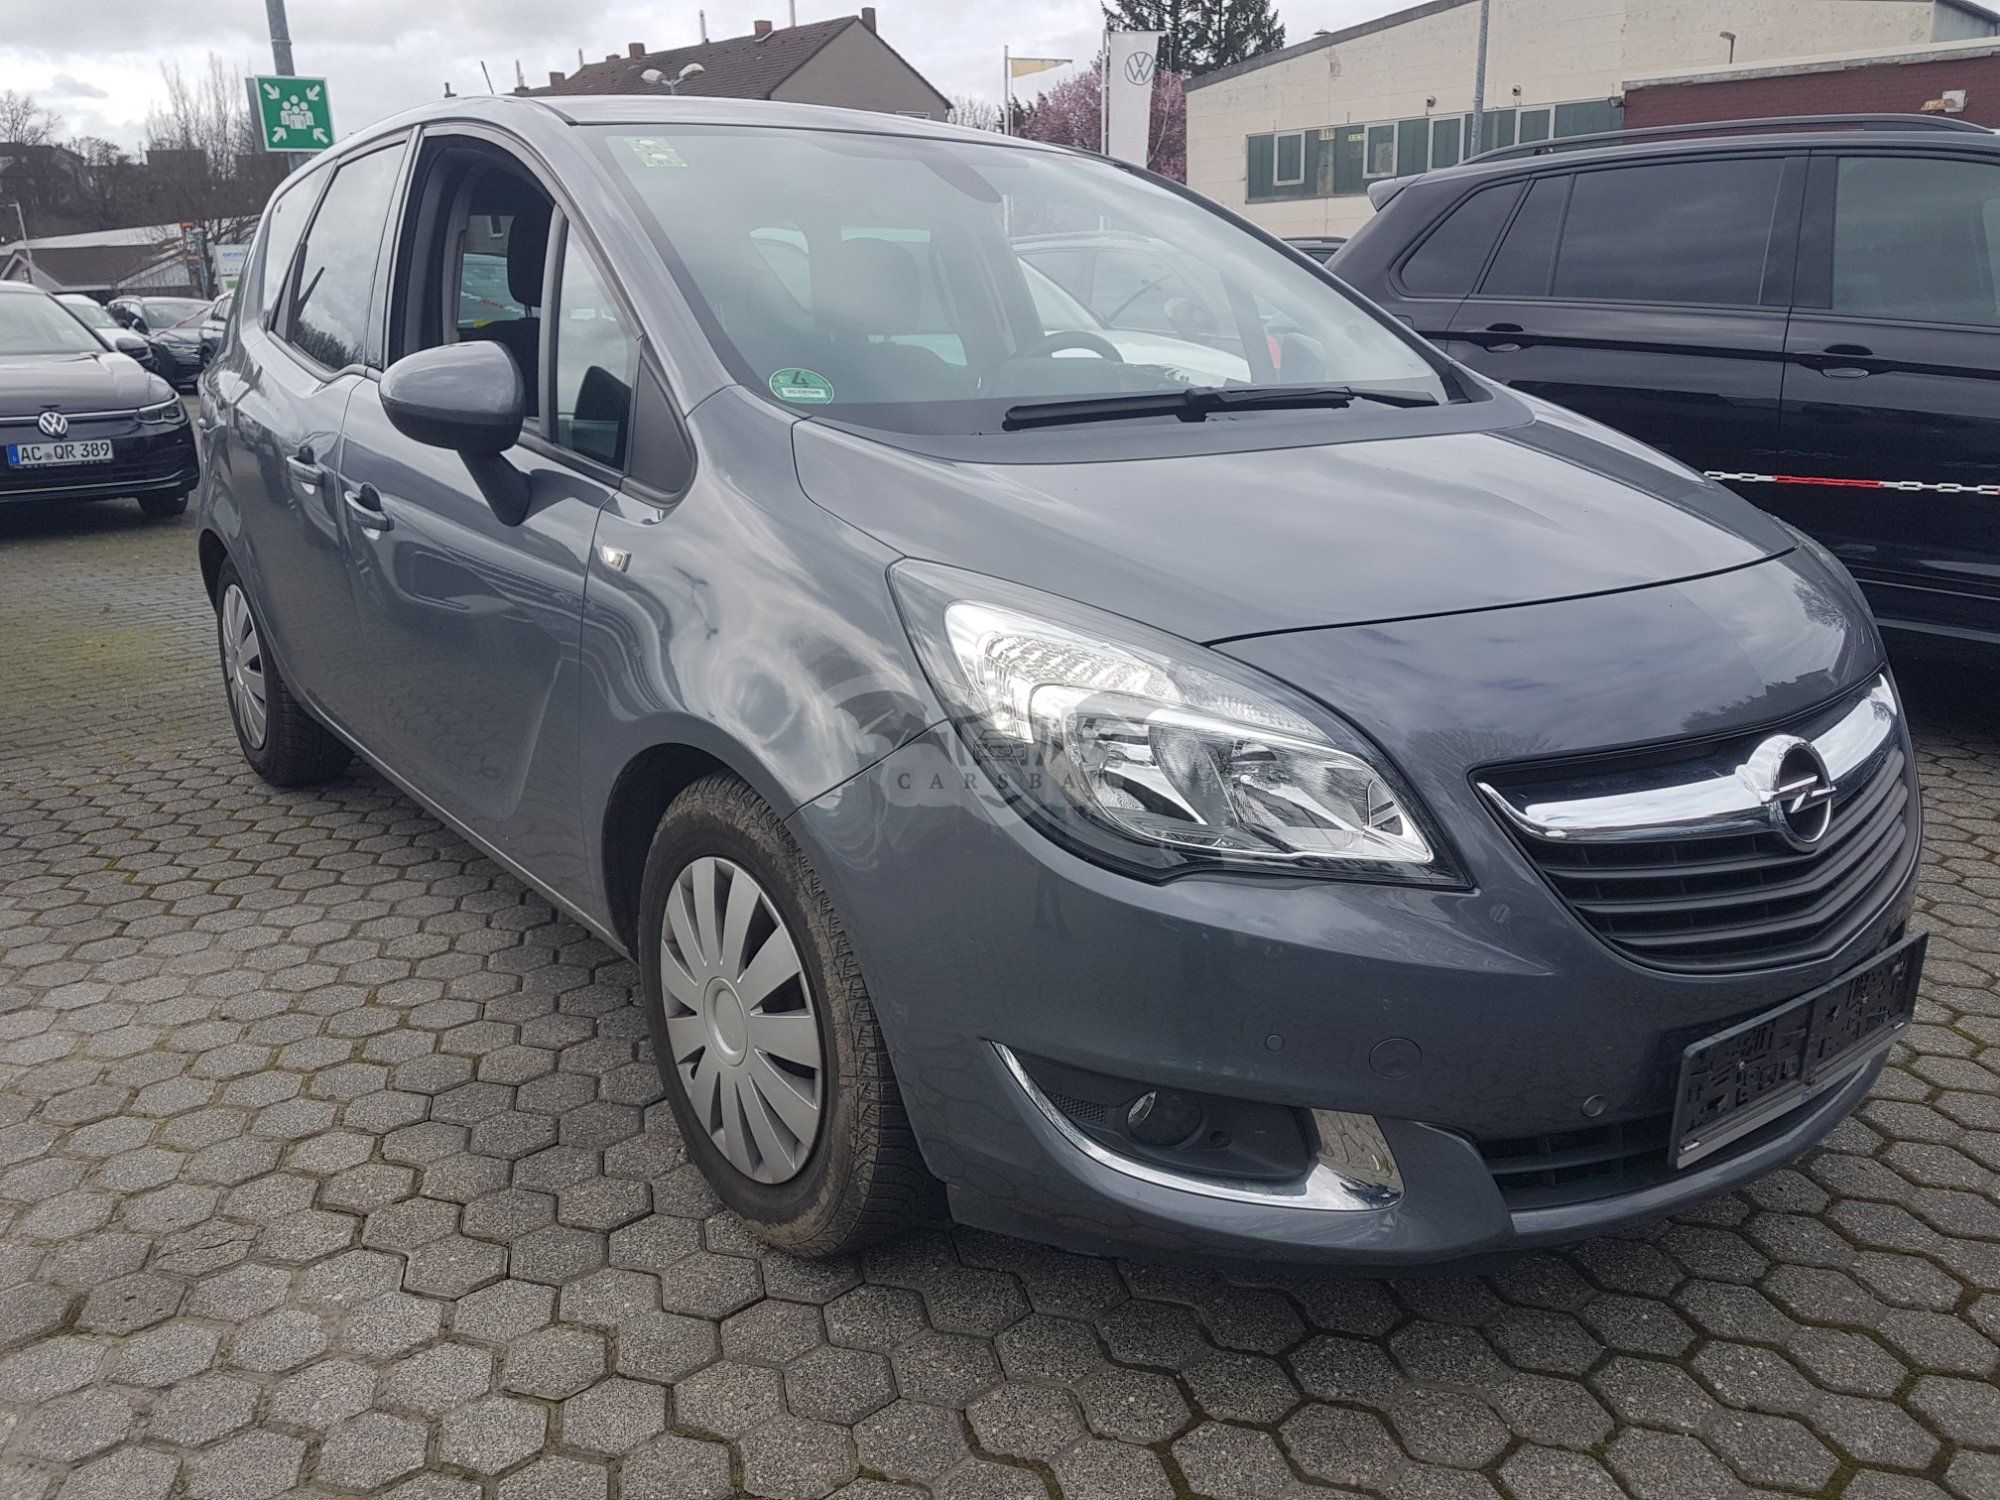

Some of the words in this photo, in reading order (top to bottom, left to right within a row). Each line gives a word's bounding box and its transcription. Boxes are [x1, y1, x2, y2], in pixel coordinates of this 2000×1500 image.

[21, 446, 42, 462] AC
[53, 443, 76, 460] QR
[80, 441, 110, 458] 389
